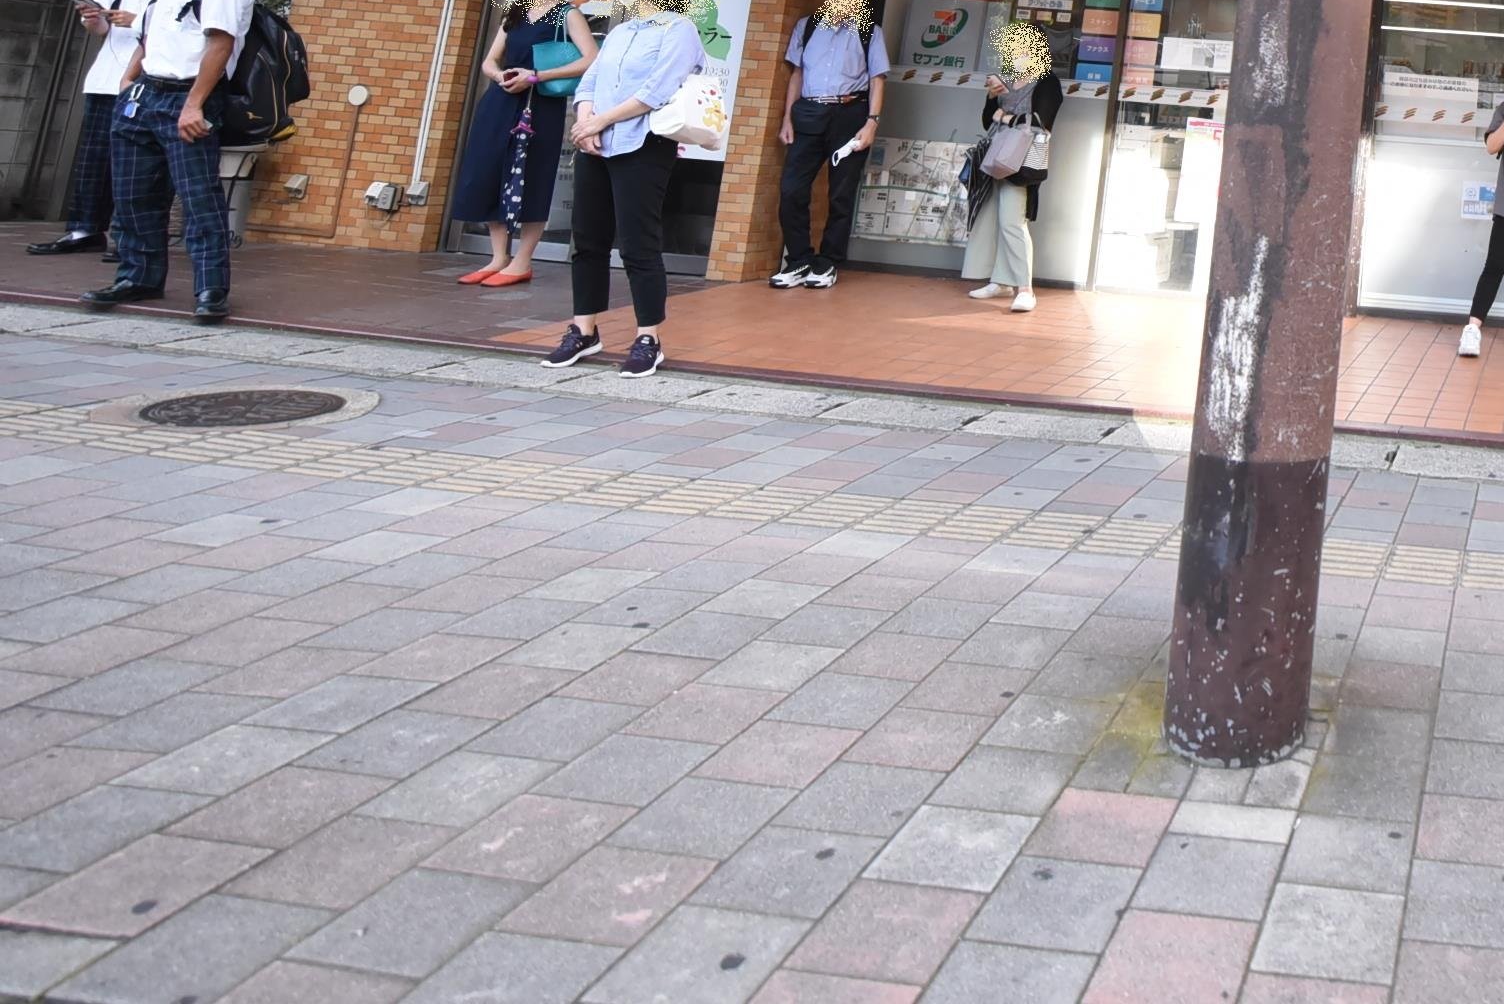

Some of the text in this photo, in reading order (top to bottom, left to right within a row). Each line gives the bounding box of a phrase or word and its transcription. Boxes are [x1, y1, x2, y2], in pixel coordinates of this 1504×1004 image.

[912, 52, 966, 68] セブン銀行
